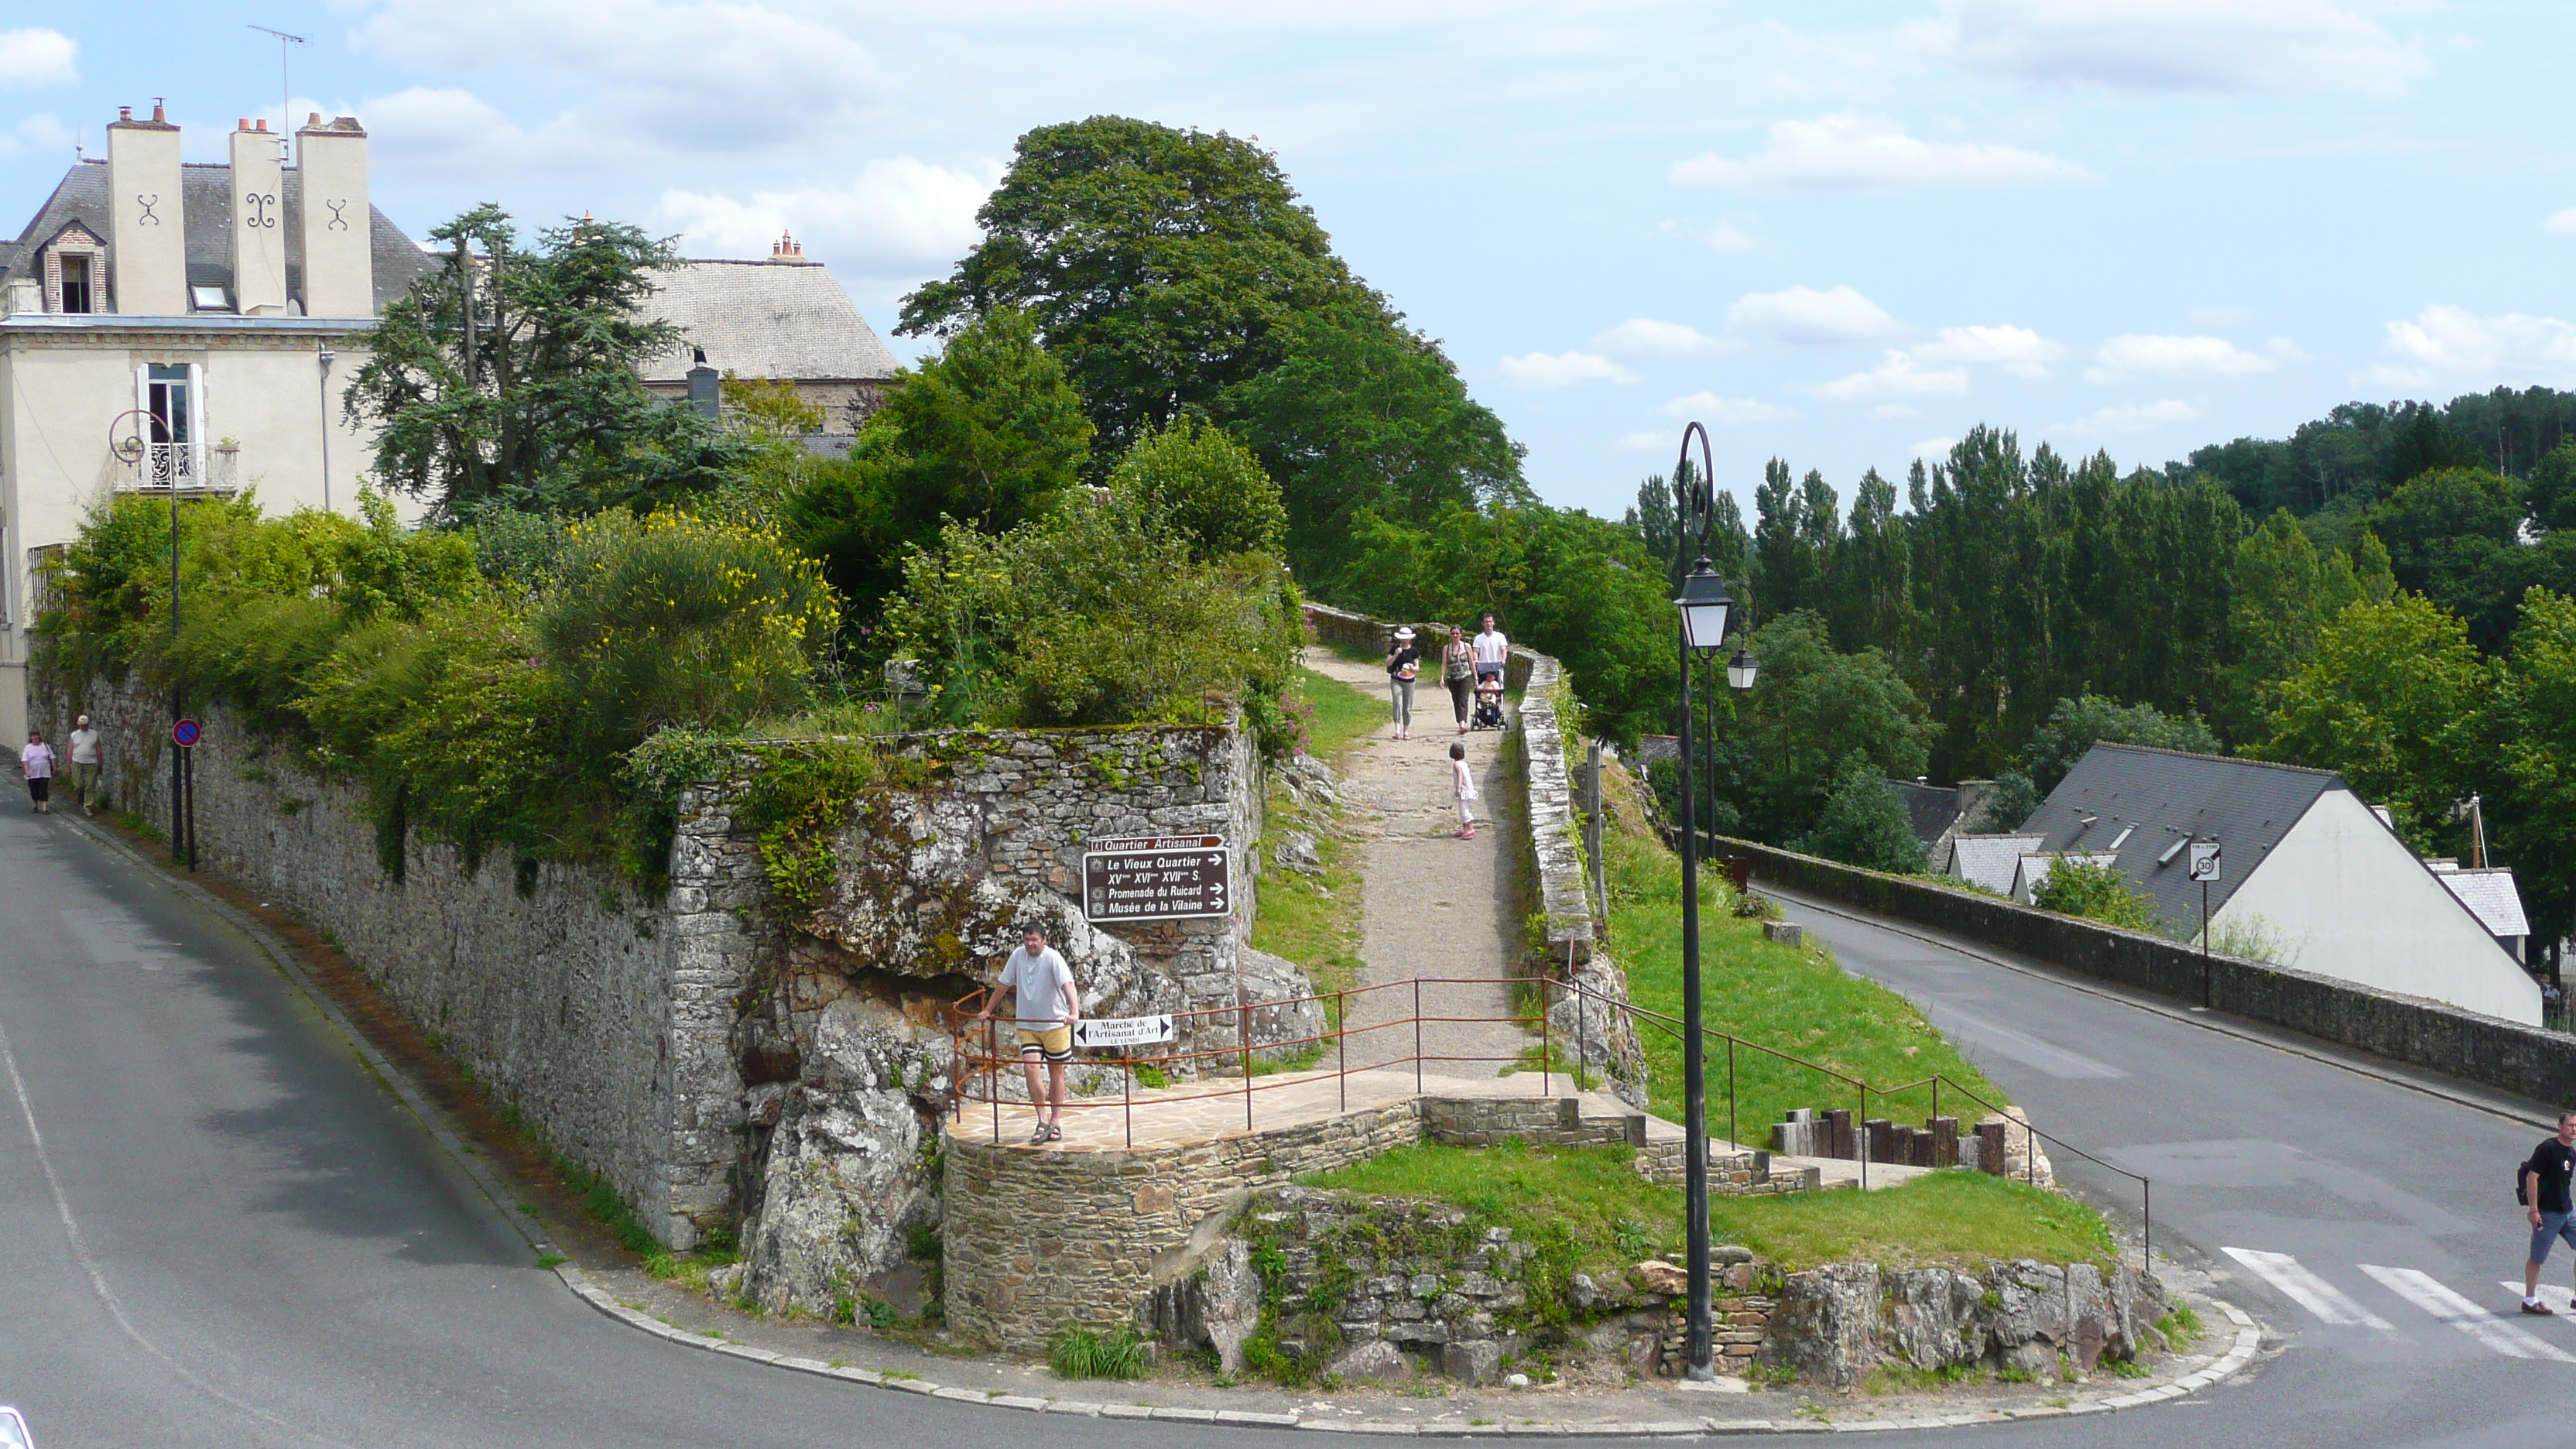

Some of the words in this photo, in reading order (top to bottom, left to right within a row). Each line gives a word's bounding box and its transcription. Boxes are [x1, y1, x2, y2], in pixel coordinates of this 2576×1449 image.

[1105, 840, 1148, 851] Quartier
[1154, 838, 1201, 848] Artisanal
[1108, 860, 1119, 870] Le
[1124, 858, 1152, 869] Vieux
[1157, 856, 1201, 868] Quartier
[1108, 888, 1154, 899] Promenade
[1157, 886, 1167, 896] du
[1170, 885, 1201, 896] Ruicard
[1109, 902, 1140, 913] Musée
[1145, 901, 1156, 912] de
[1160, 901, 1168, 911] la
[1173, 900, 1203, 910] Vilaine
[1101, 1020, 1134, 1029] Marché
[1088, 1029, 1135, 1038] l'Artisanat
[1139, 1026, 1158, 1036] d'Art
